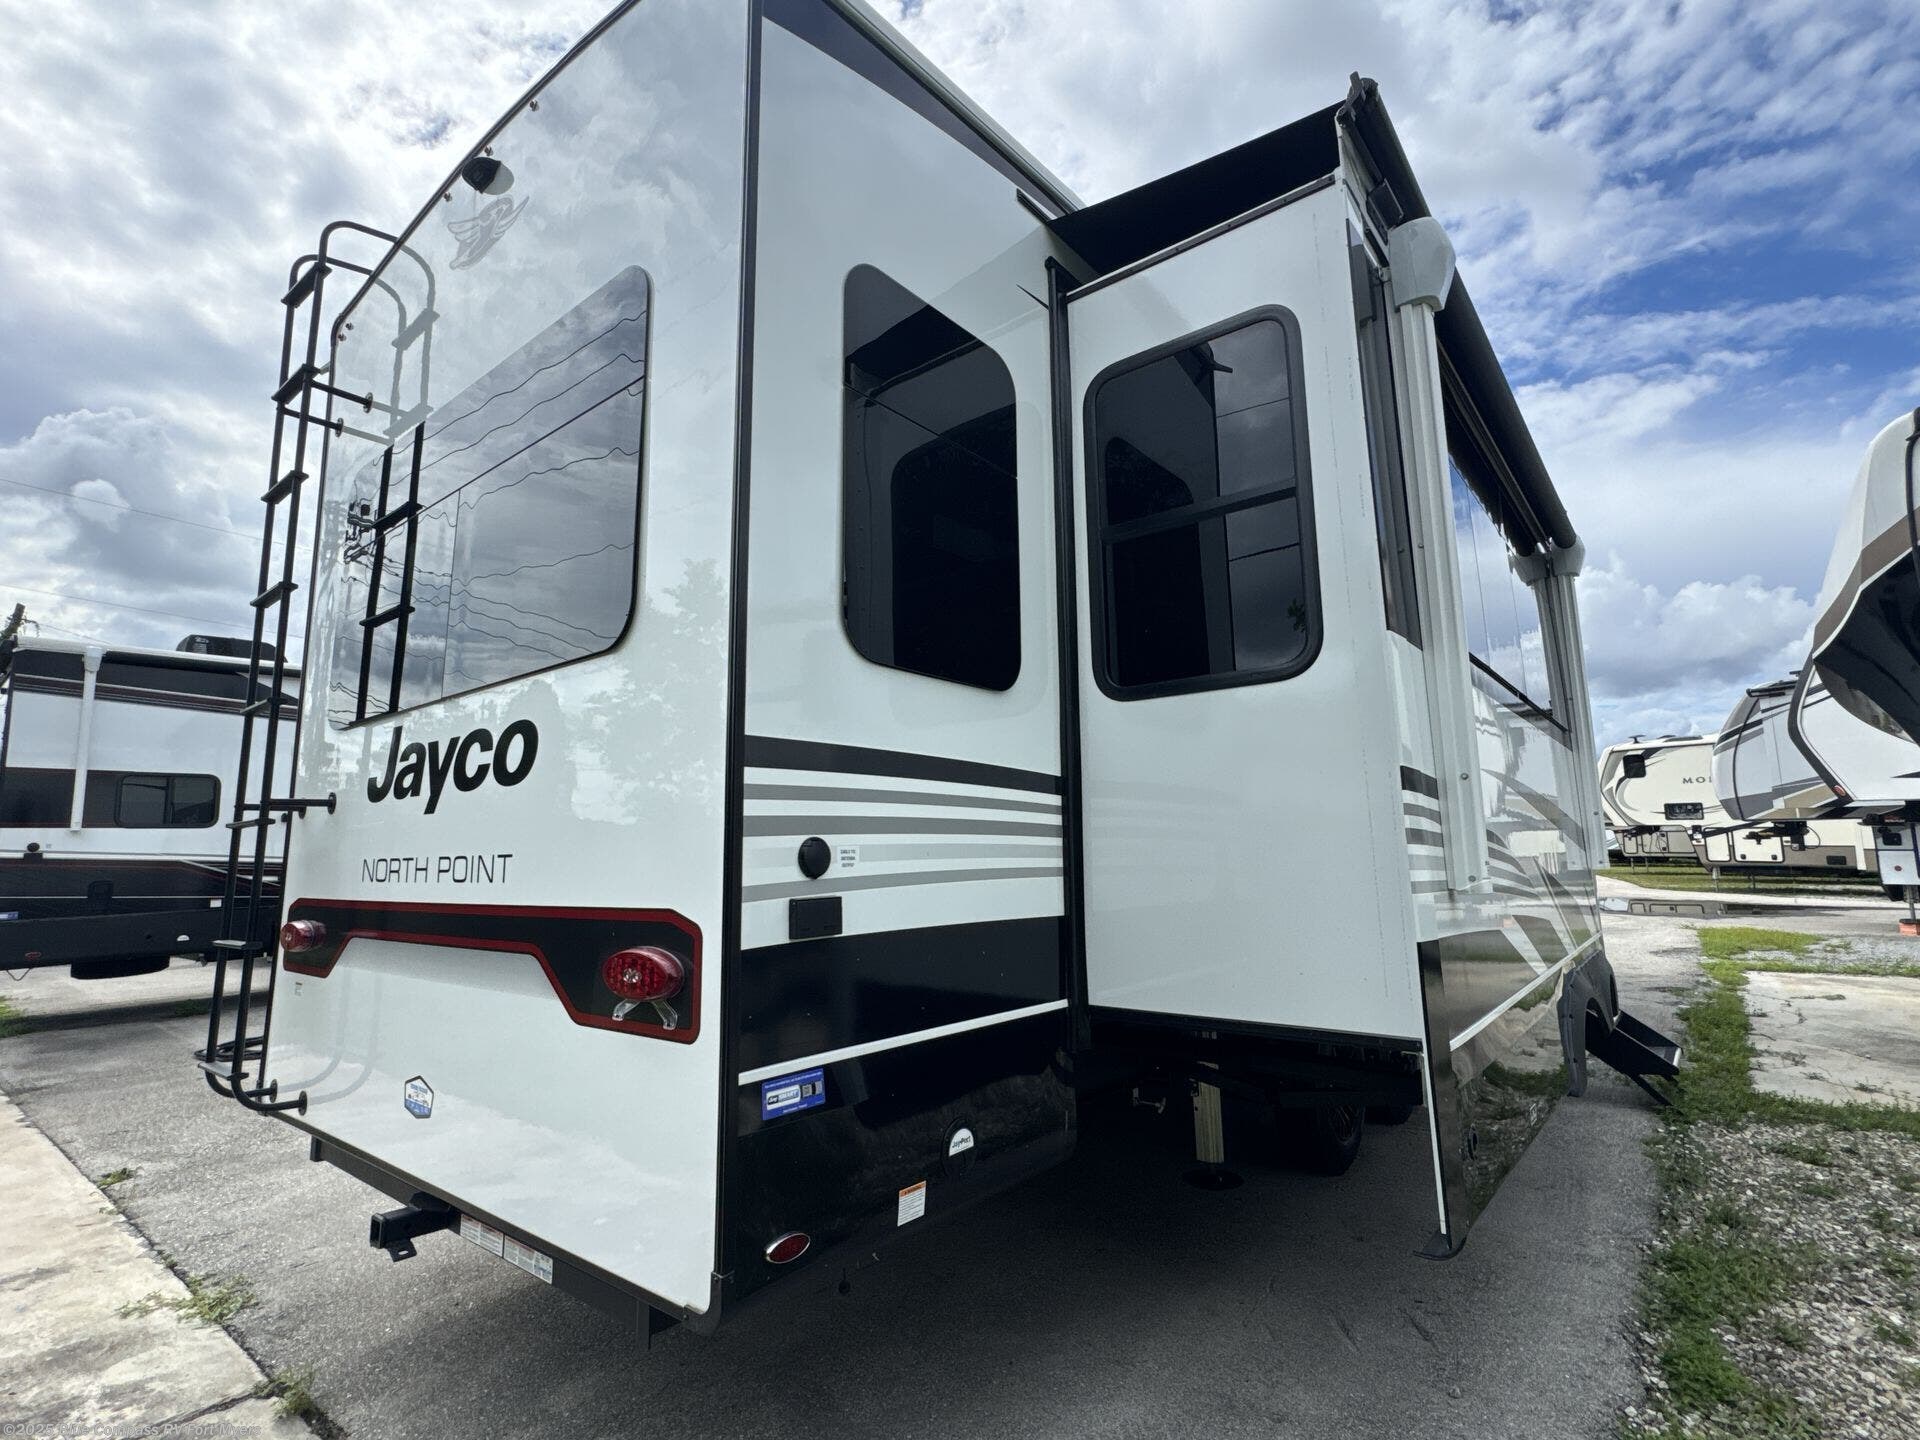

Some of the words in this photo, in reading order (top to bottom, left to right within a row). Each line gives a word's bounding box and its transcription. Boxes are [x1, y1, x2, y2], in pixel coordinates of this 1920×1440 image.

[367, 719, 539, 815] Jayco
[361, 857, 429, 883] NORTH
[436, 854, 513, 884] POINT
